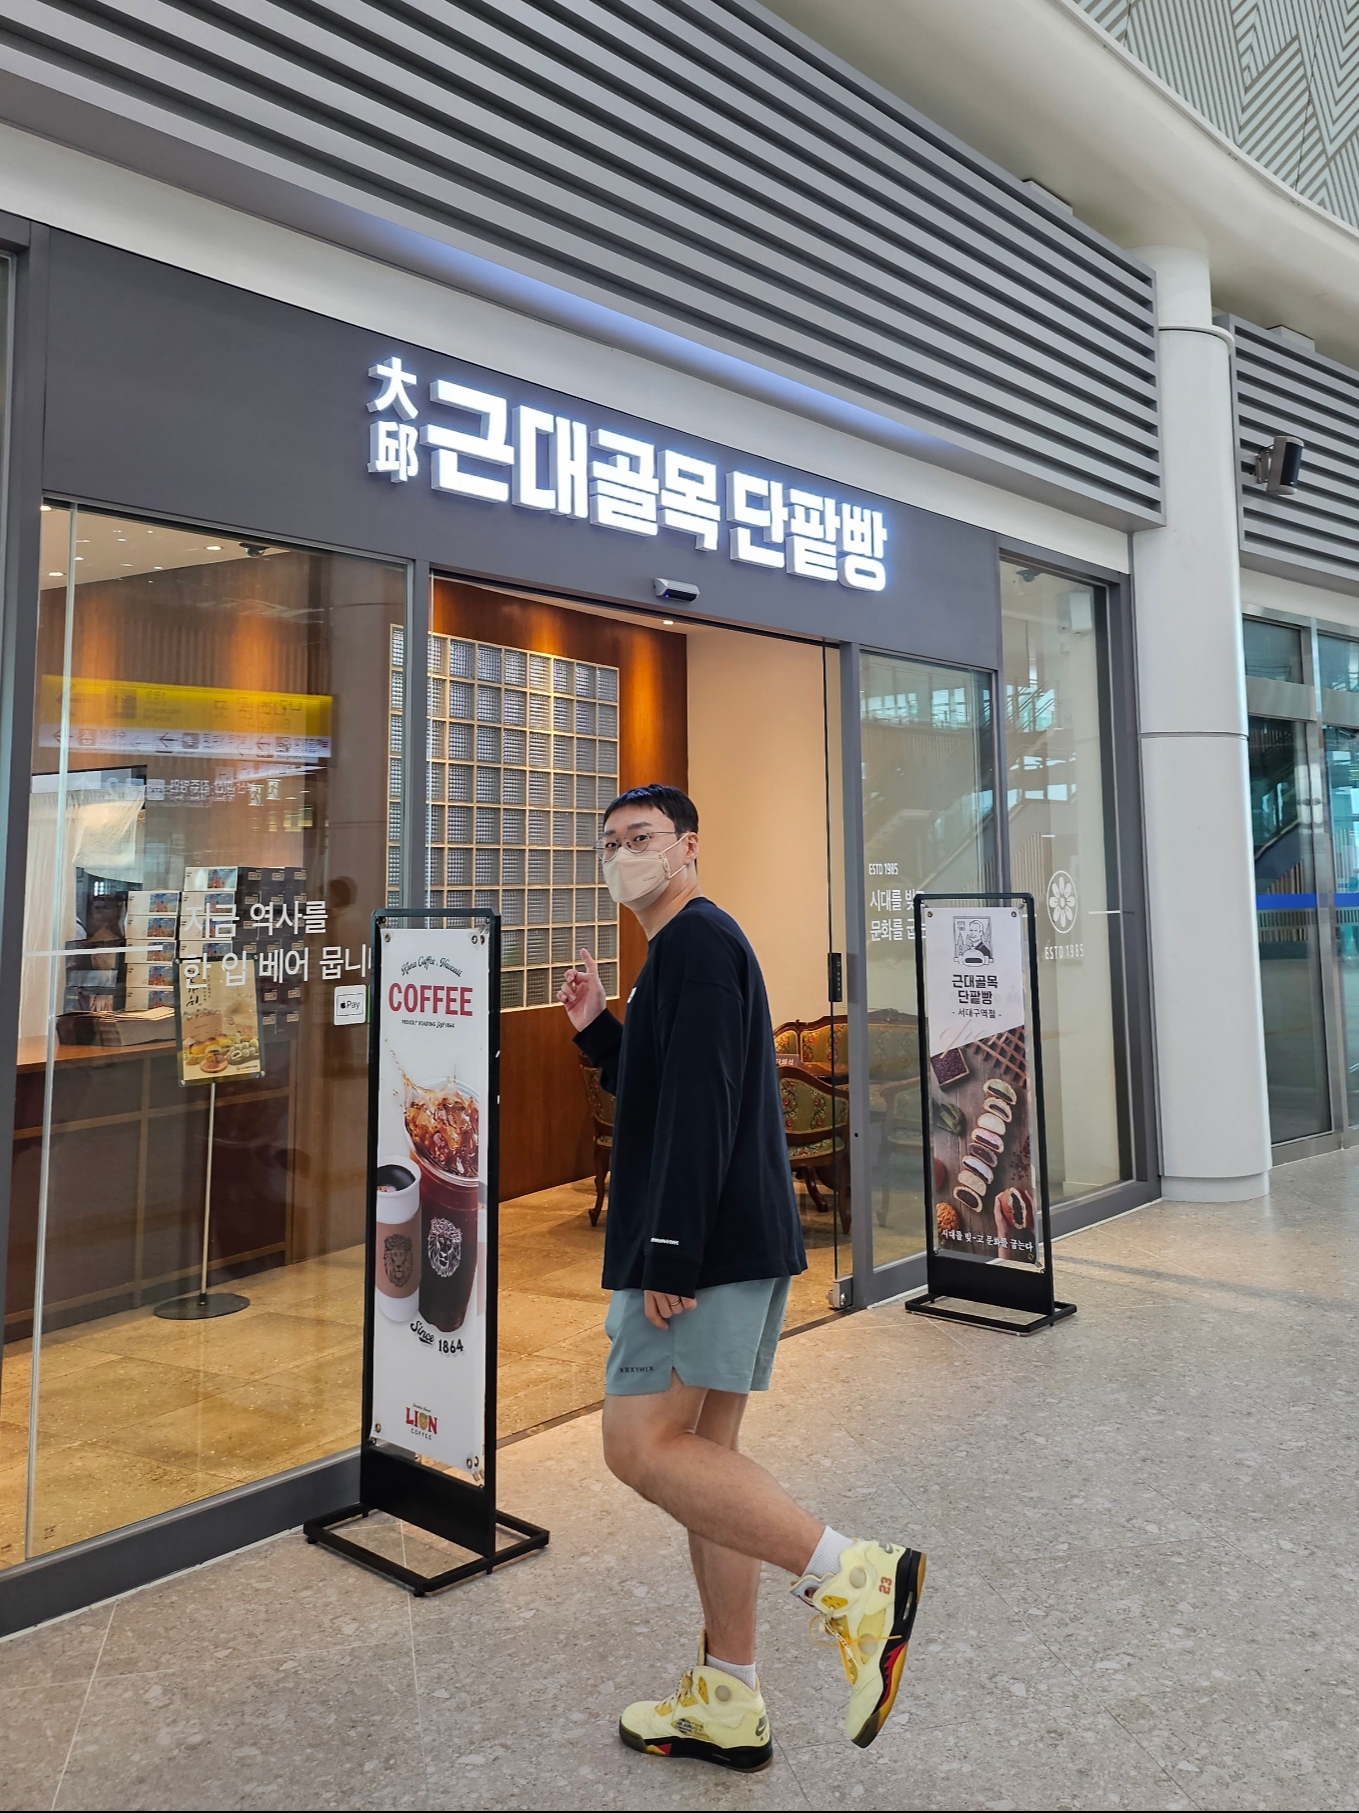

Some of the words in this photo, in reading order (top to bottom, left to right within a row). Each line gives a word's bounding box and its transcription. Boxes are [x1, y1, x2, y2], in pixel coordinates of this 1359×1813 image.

[367, 356, 420, 483] 大邱
[419, 378, 721, 552] 근대골목
[725, 470, 888, 592] 단팥빵
[868, 863, 883, 875] ESTD
[884, 862, 899, 875] 1985
[869, 888, 902, 911] 시대를
[184, 902, 240, 939] 지금
[250, 900, 328, 936] 역사를
[870, 918, 903, 942] 문화를
[1044, 945, 1063, 960] ESTD
[1065, 943, 1084, 959] 1985
[182, 951, 211, 989] 한
[222, 950, 247, 987] 입
[258, 947, 309, 984] 베어
[319, 943, 372, 980] 뭅니
[951, 974, 998, 989] 근대골목
[346, 999, 361, 1012] Pay
[388, 982, 473, 1017] COFFEE
[957, 989, 993, 1005] 단팥빵
[957, 1008, 996, 1019] 서대구역점
[940, 1228, 963, 1241] 시대를
[986, 1235, 1008, 1248] 문화를
[1010, 1238, 1034, 1252] 굽는다
[410, 1320, 435, 1345] Since
[438, 1338, 464, 1354] 1864
[878, 1576, 893, 1595] 23
